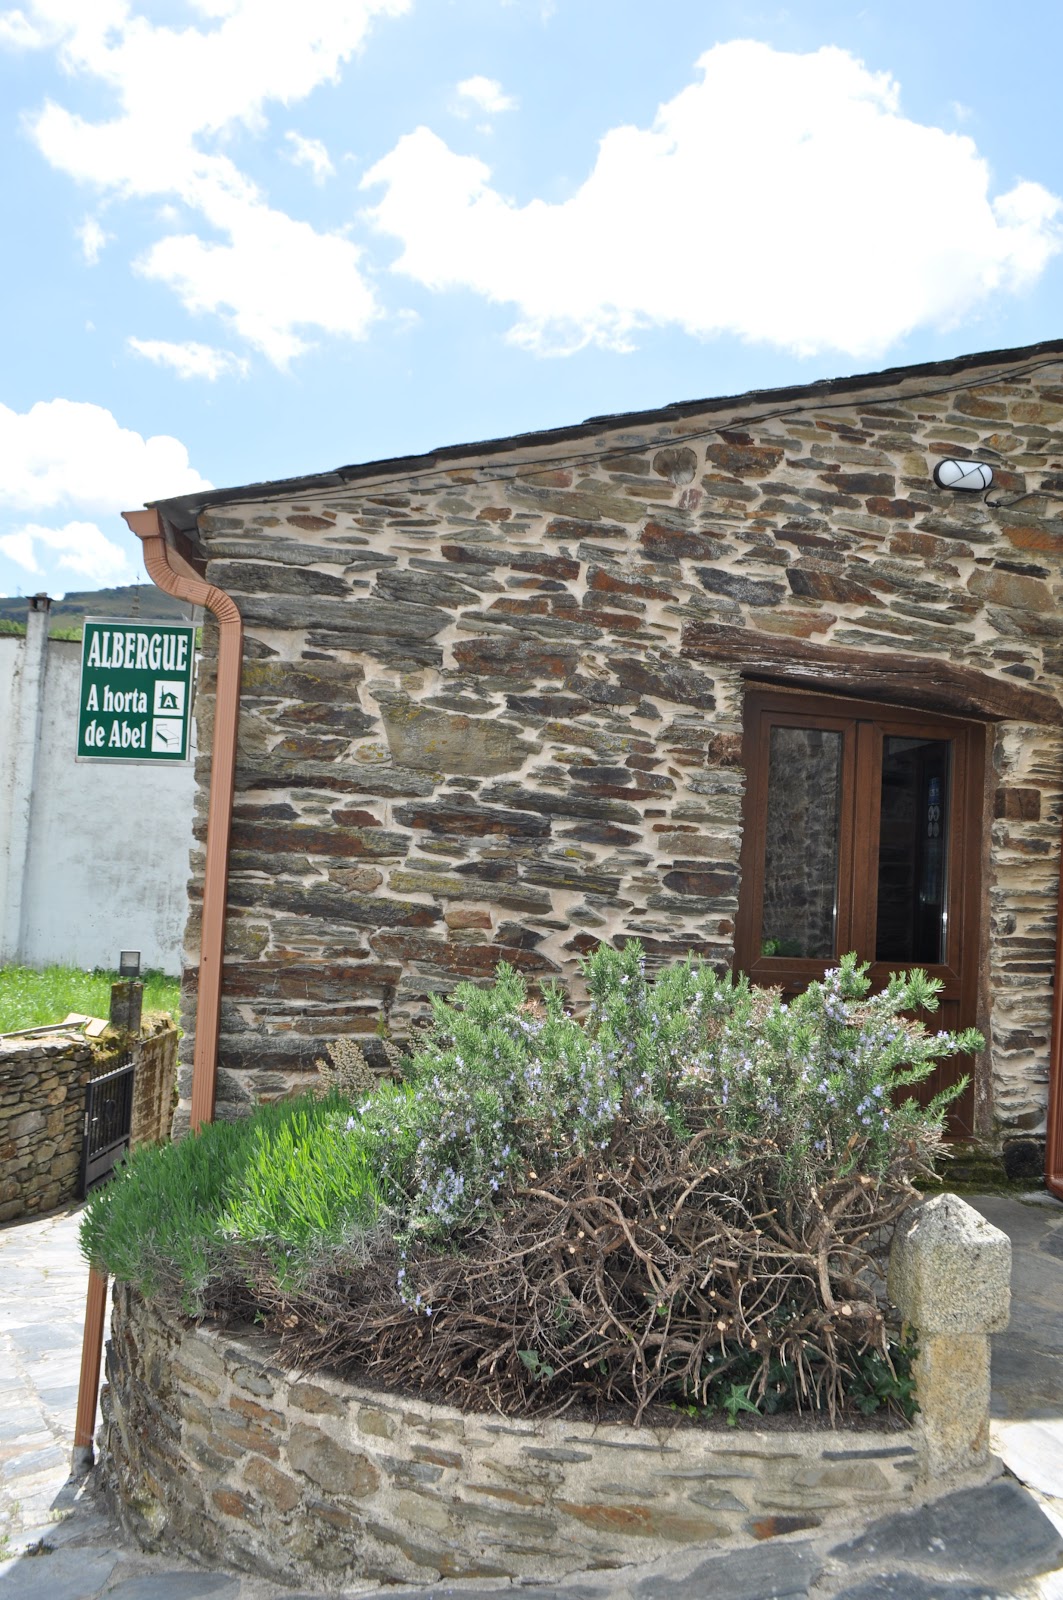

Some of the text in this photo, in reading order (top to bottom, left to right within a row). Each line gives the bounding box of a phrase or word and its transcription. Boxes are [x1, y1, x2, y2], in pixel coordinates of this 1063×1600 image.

[87, 631, 188, 671] ALBERGUE
[86, 684, 147, 713] A horta
[163, 696, 174, 708] A
[84, 719, 147, 748] de Abel
